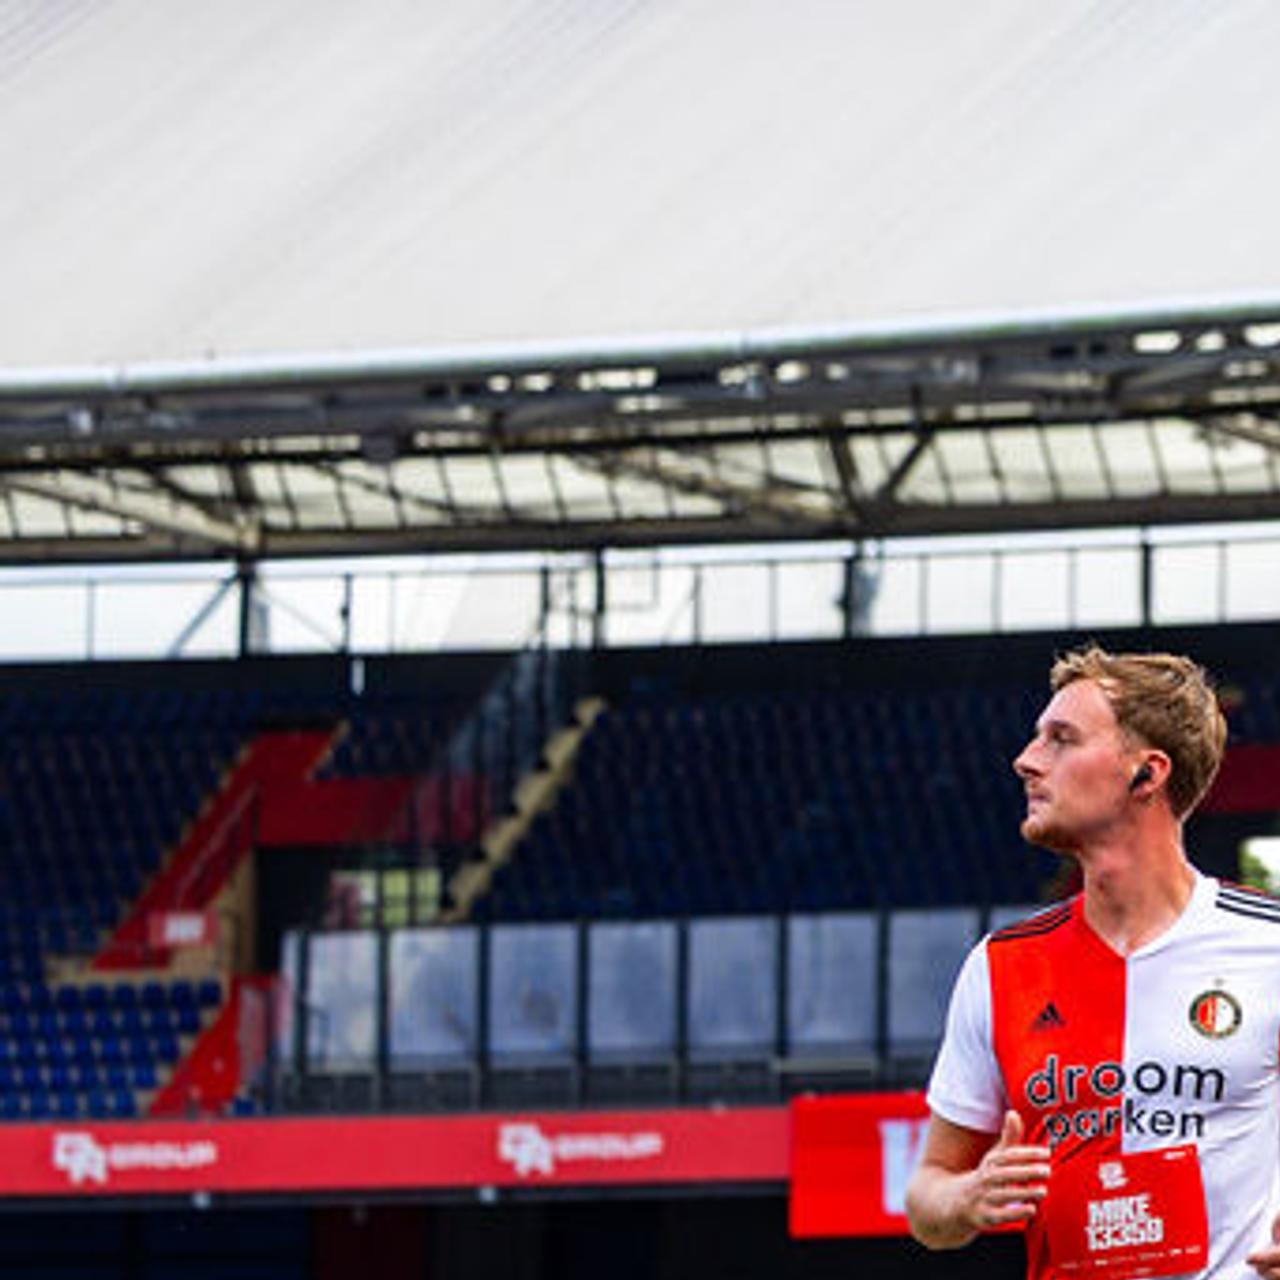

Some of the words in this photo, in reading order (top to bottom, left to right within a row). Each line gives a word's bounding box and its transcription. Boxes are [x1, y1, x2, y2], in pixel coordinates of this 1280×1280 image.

[1025, 1054, 1226, 1108] droom
[1045, 1098, 1206, 1147] parken
[1087, 1193, 1152, 1229] MIKE
